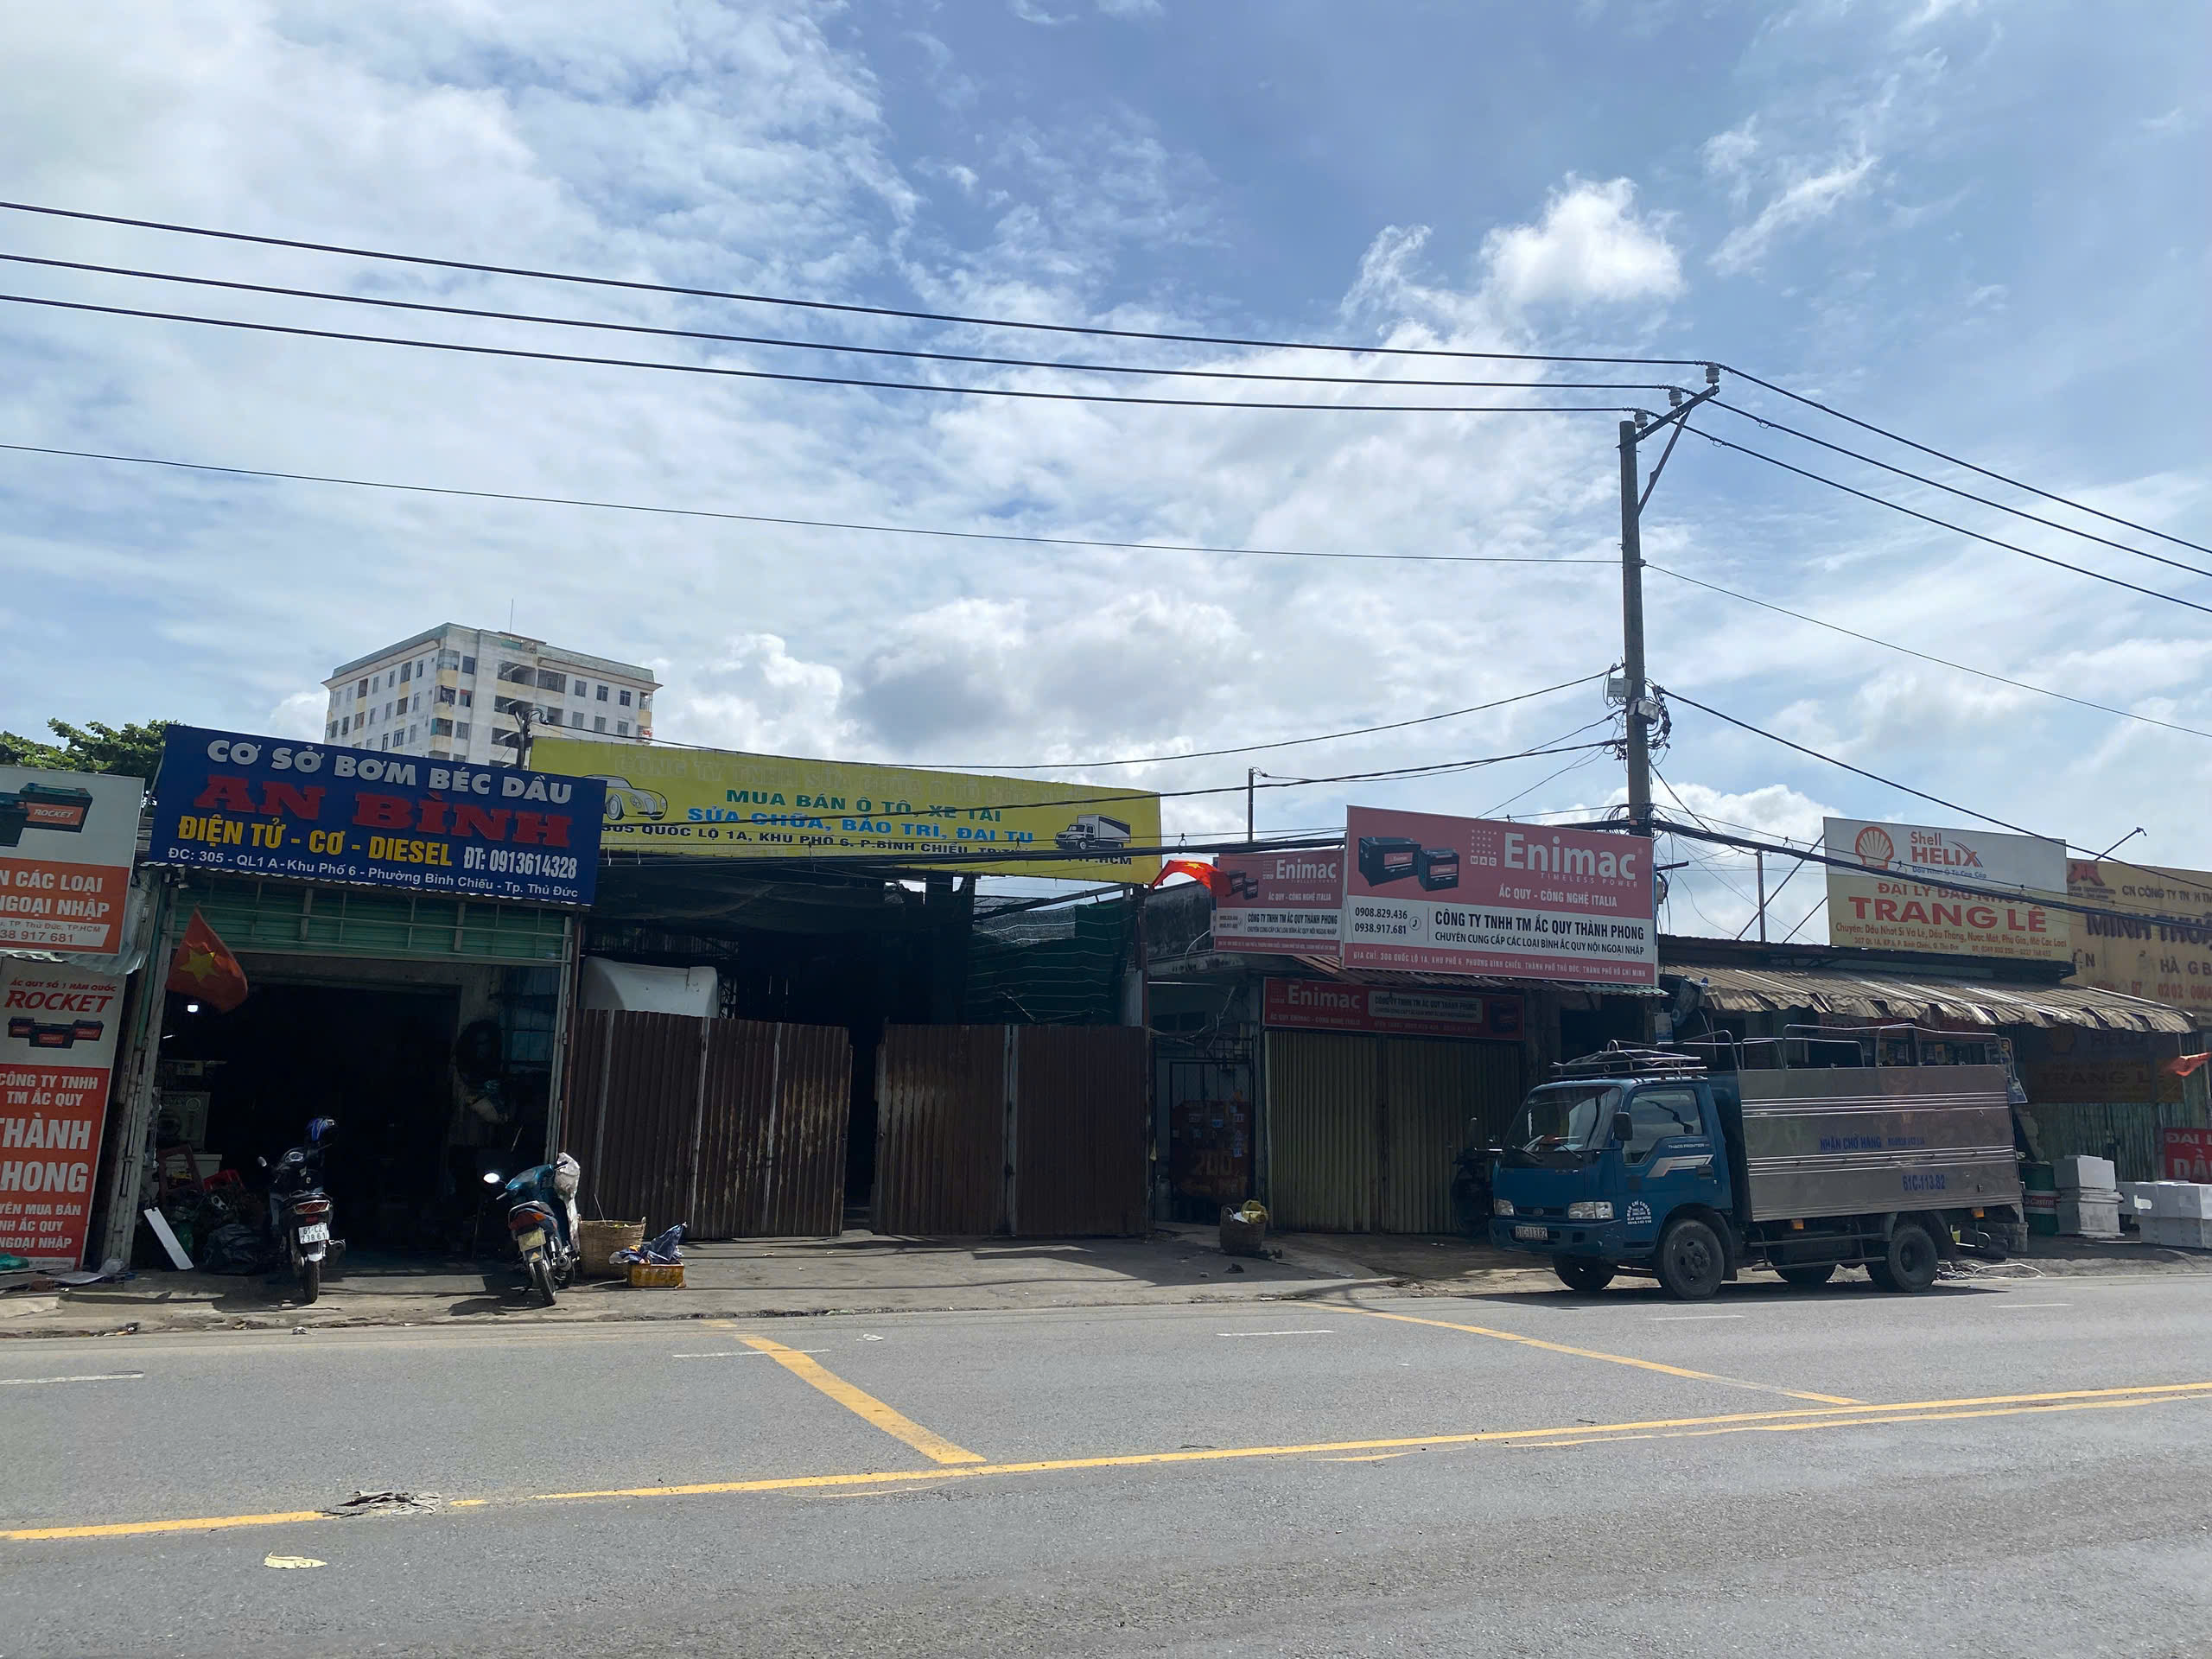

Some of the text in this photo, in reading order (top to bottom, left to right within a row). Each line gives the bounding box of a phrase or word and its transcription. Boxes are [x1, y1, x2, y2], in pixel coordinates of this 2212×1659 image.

[207, 740, 572, 804] CƠ SỞ BƠM BÉC DẦU
[35, 809, 73, 818] ROCKET
[194, 774, 574, 849] AN BÌNH
[727, 789, 785, 806] MUA
[796, 793, 846, 810] BÁN
[856, 797, 872, 812] Ô
[929, 805, 957, 818] XE
[688, 804, 741, 822] SỬA
[900, 823, 947, 841] TRÌ,
[178, 814, 577, 880] ĐIỆN TỬ CƠ DIESEL ĐT: 0913614328
[698, 827, 720, 841] LỘ
[760, 832, 793, 844] KHU
[1910, 831, 1942, 847] Shell
[1504, 832, 1637, 880] Enimac
[1911, 846, 1983, 868] HELIX
[168, 848, 194, 861] ĐC:
[199, 851, 225, 863] 305
[318, 861, 345, 875] Phố
[348, 865, 357, 876] 6
[368, 867, 421, 885] Phường
[425, 873, 454, 887] Bình
[505, 881, 524, 894] Tp.
[528, 883, 550, 896] Thủ
[553, 885, 578, 899] Đức
[1276, 859, 1337, 880] Enimac
[1541, 873, 1638, 888] TIMELESS POWER
[16, 868, 104, 896] CÁC LOẠI
[2122, 885, 2136, 897] CN
[2138, 884, 2164, 899] CÔNG
[2167, 889, 2177, 899] TY
[1499, 883, 1618, 907] ẮC QUY CÔNG NGHỆ ITALIA
[57, 898, 111, 920] NHẬP
[1355, 906, 1408, 920] 0908.829.436
[1848, 896, 1999, 929] TRANG
[2007, 906, 2047, 932] LÊ
[1354, 922, 1407, 935] 0938.917.681
[1435, 908, 1644, 941] CÔNG TY TNHH TM ẮC QUY THÀNH PHONG
[21, 931, 74, 944] 917 681
[1435, 931, 1465, 943] CHUYÊN
[1469, 934, 1489, 944] CUNG
[1541, 938, 1559, 950] BÌNH
[1571, 942, 1586, 952] QUY
[1601, 945, 1624, 957] NGOẠI
[4, 990, 113, 1014] ROCKET
[1287, 985, 1360, 1009] Enimac
[41, 1075, 57, 1088] TY
[61, 1076, 99, 1090] TNHH
[7, 1087, 84, 1107] TM ẮC QUY
[0, 1112, 92, 1149] HÀNH
[0, 1161, 89, 1192] HONG
[25, 1204, 52, 1216] MUA
[55, 1202, 82, 1216] BÁN
[19, 1216, 35, 1231] ẮC
[39, 1221, 64, 1233] QUY
[38, 1235, 73, 1251] NHẬP
